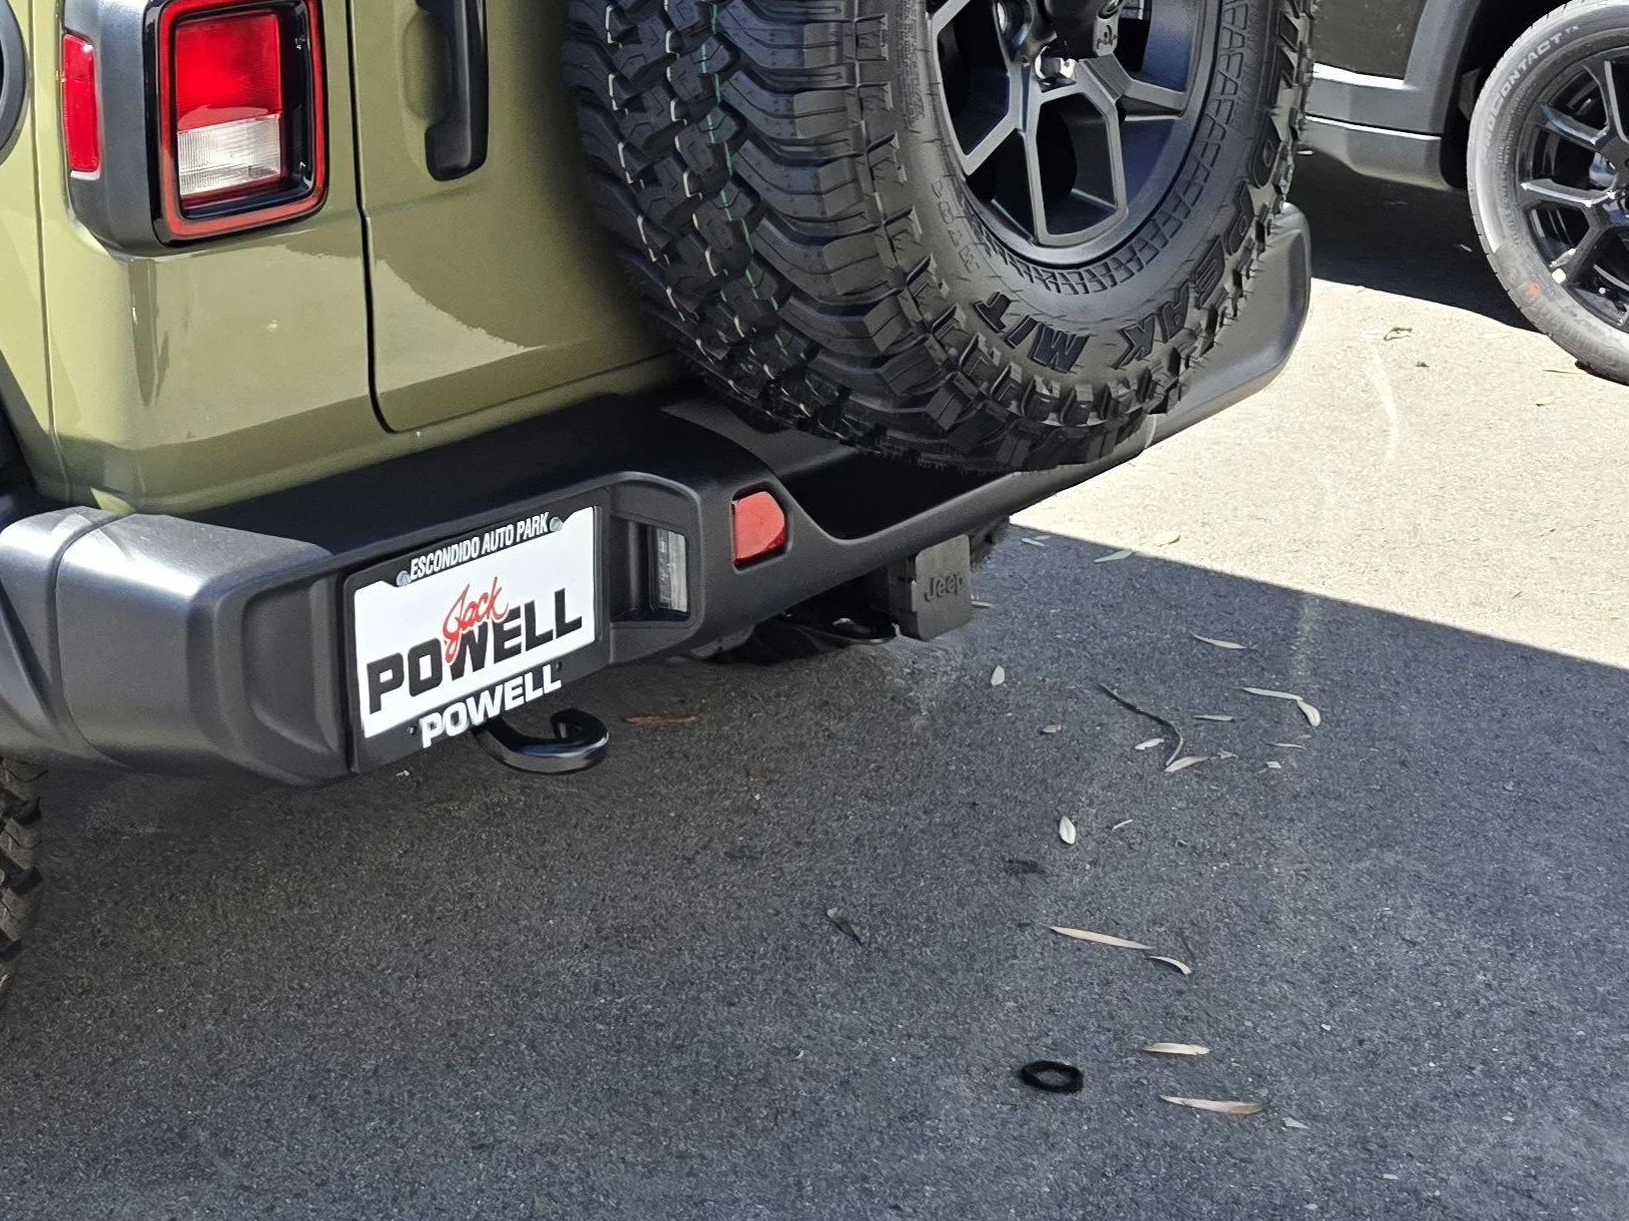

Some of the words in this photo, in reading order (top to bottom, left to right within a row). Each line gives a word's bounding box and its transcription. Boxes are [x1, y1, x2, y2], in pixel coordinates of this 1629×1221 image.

[410, 536, 480, 580] ESCONDIDO
[481, 524, 514, 555] AUTO
[517, 512, 550, 542] PARK
[923, 574, 963, 603] Jeep
[366, 587, 583, 715] POWELL
[443, 576, 510, 663] Jack
[419, 664, 562, 749] POWELL
